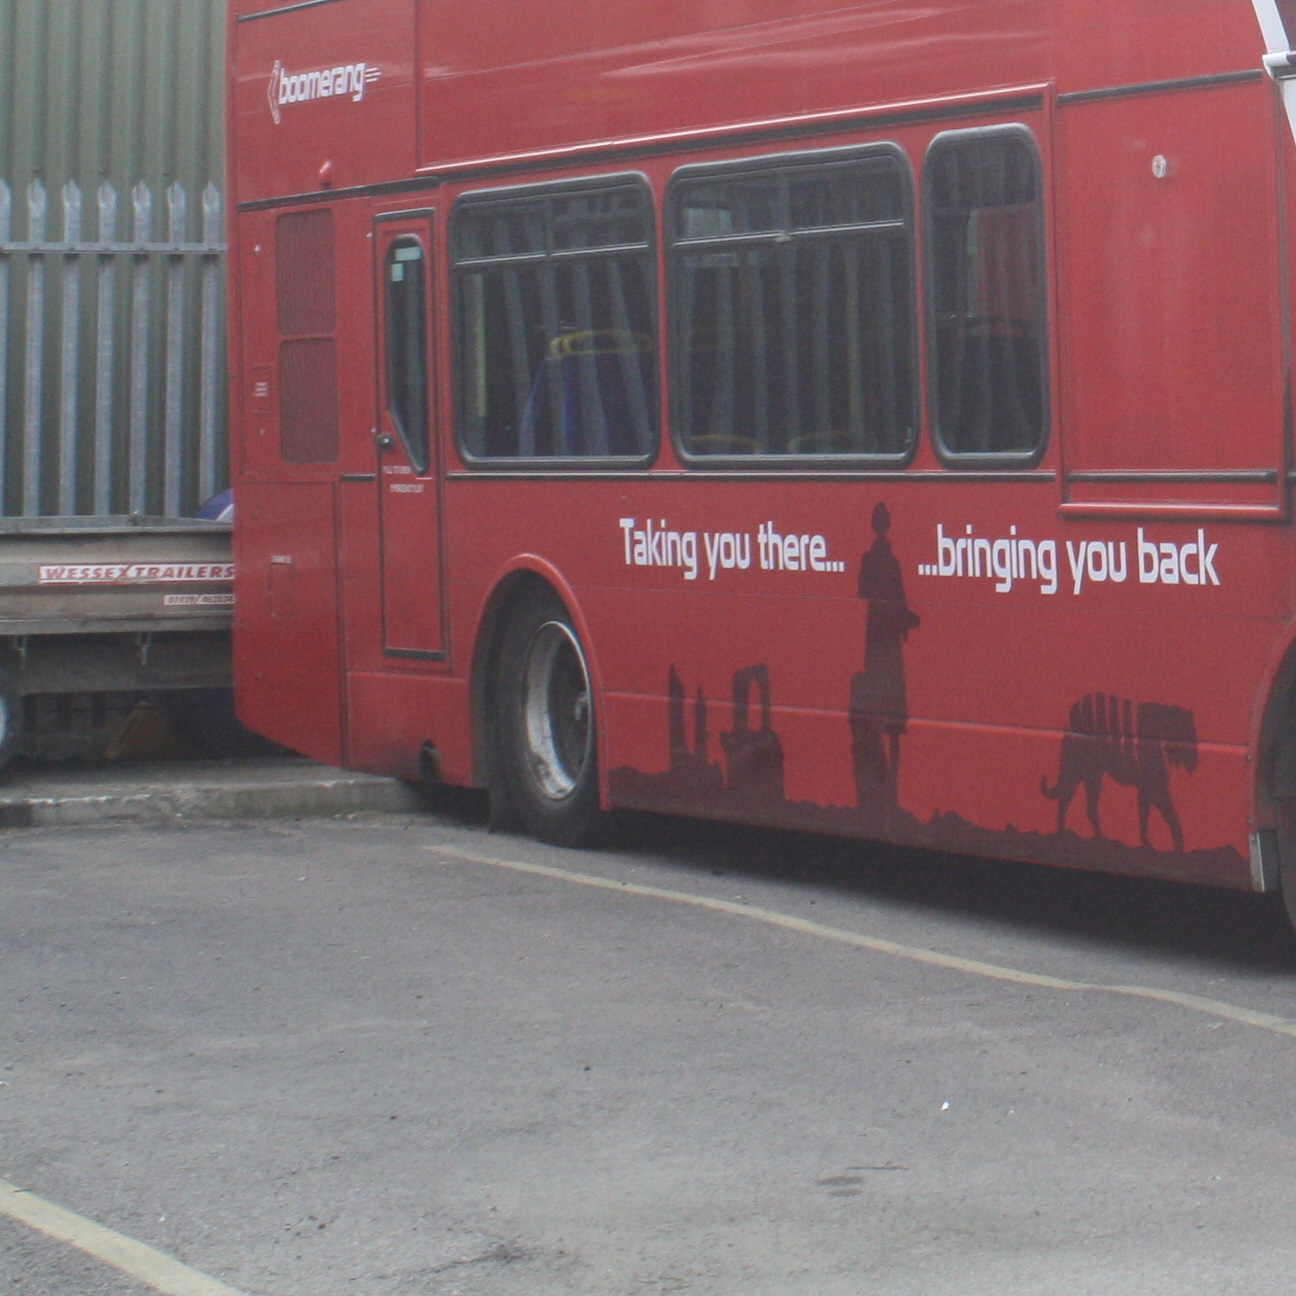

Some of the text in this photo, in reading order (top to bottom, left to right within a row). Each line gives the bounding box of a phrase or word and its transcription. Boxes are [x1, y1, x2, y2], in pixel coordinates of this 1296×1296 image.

[278, 62, 367, 105] boomerang
[46, 564, 234, 580] WESSEX TRAILERS
[619, 517, 845, 581] Taking you there...
[917, 523, 1221, 595] ...bringing you back
